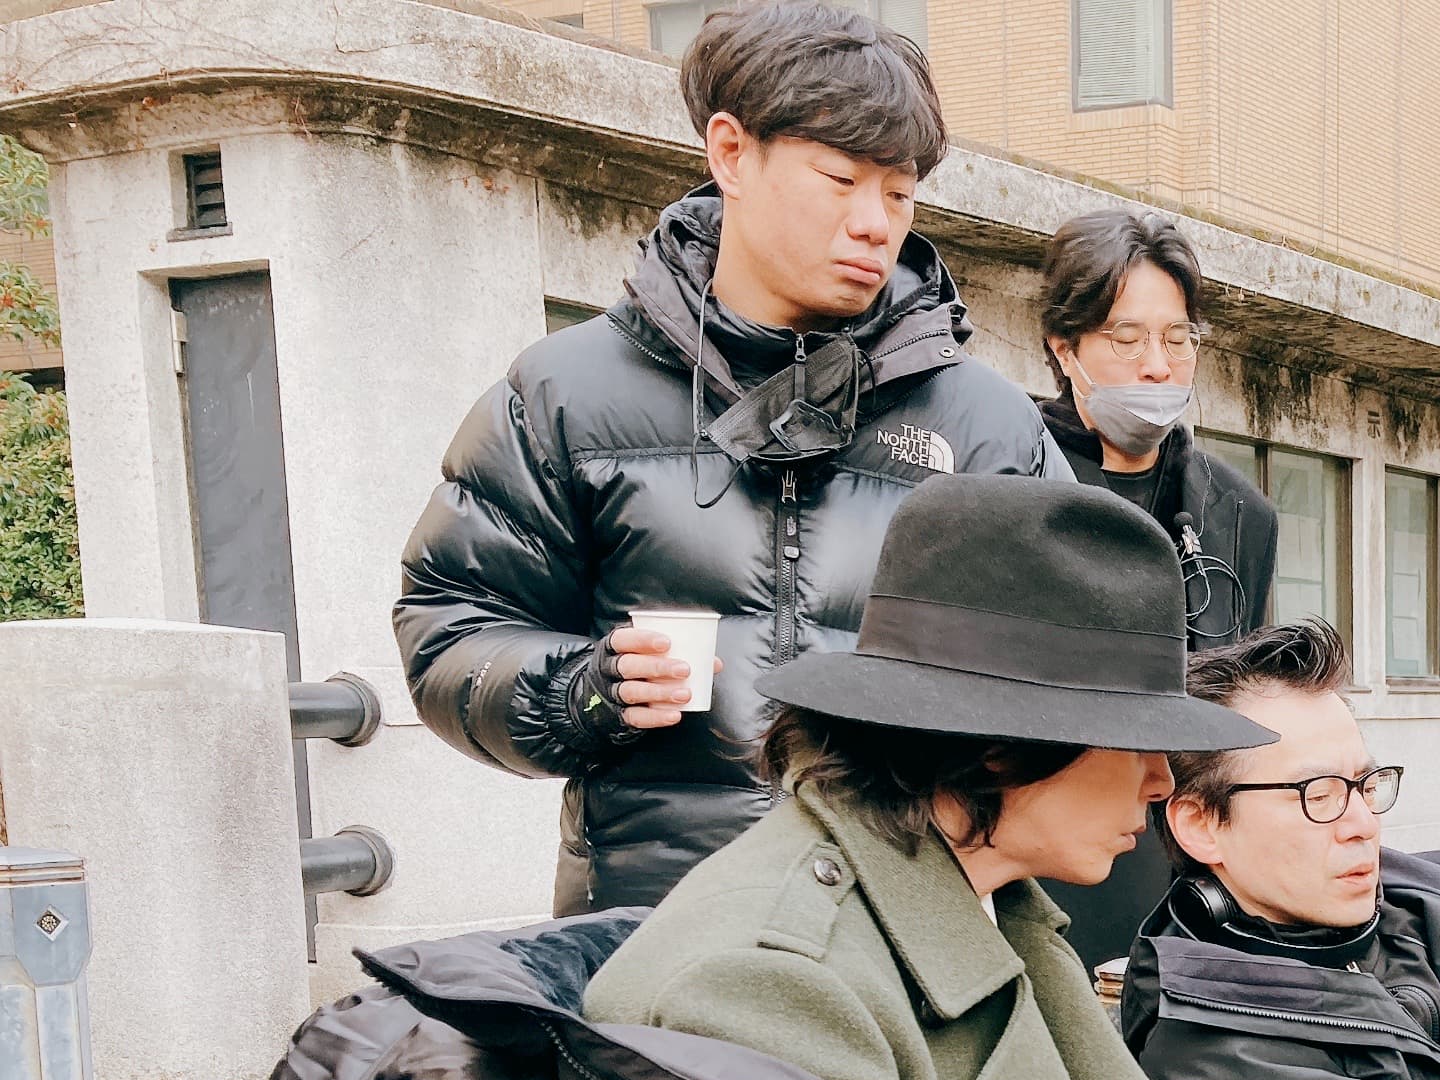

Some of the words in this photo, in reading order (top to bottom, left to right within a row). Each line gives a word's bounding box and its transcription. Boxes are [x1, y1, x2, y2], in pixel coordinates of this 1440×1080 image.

[877, 430, 929, 455] NORTH
[901, 423, 931, 442] THE
[891, 446, 929, 467] FACE
